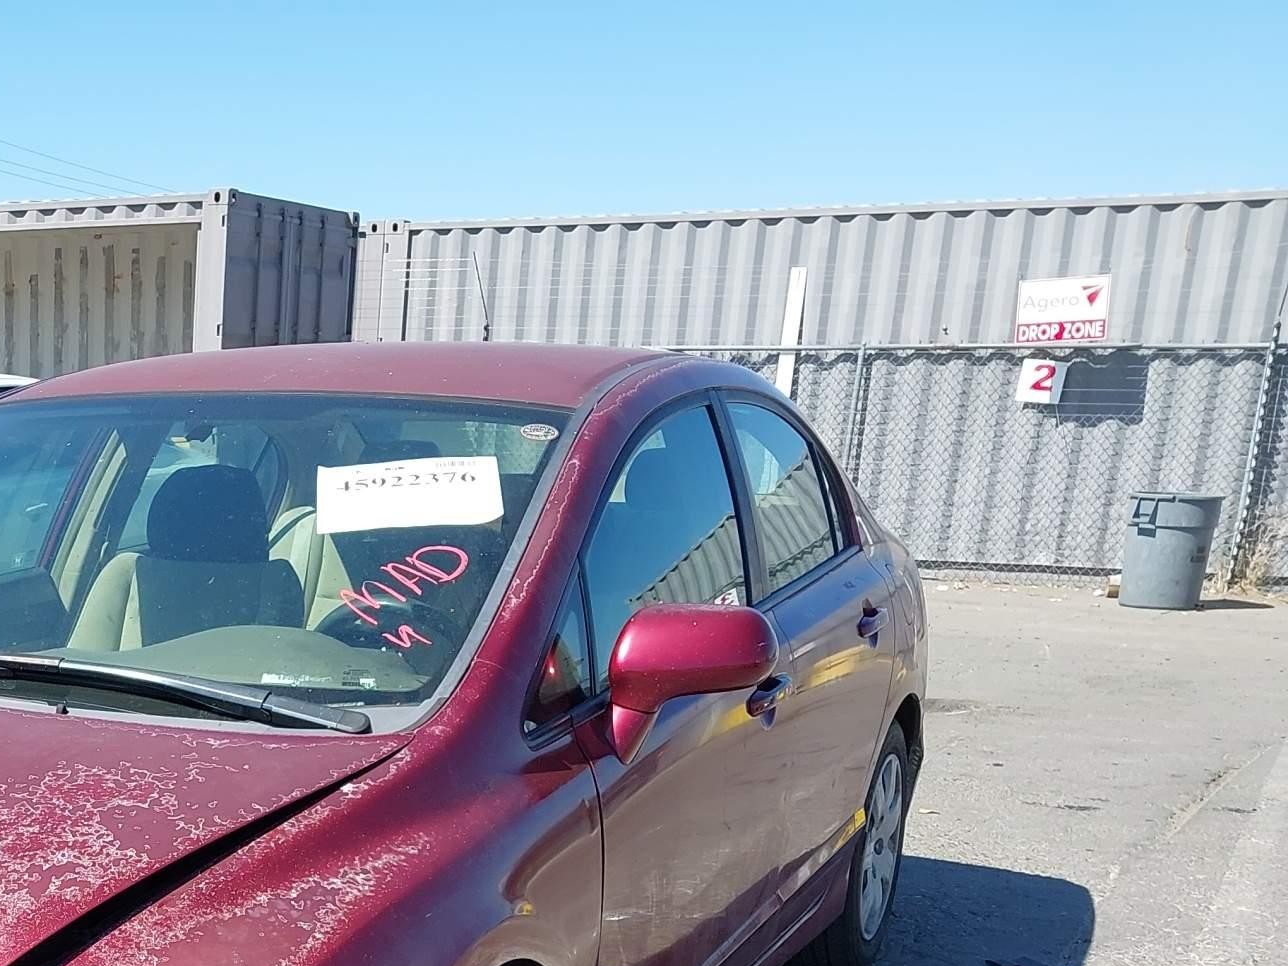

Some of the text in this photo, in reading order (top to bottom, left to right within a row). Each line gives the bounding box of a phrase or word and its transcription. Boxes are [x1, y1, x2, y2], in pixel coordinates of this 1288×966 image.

[1022, 295, 1080, 312] Agero
[1018, 320, 1105, 341] DROP ZONE
[1030, 364, 1057, 392] 2
[340, 545, 469, 625] MAD
